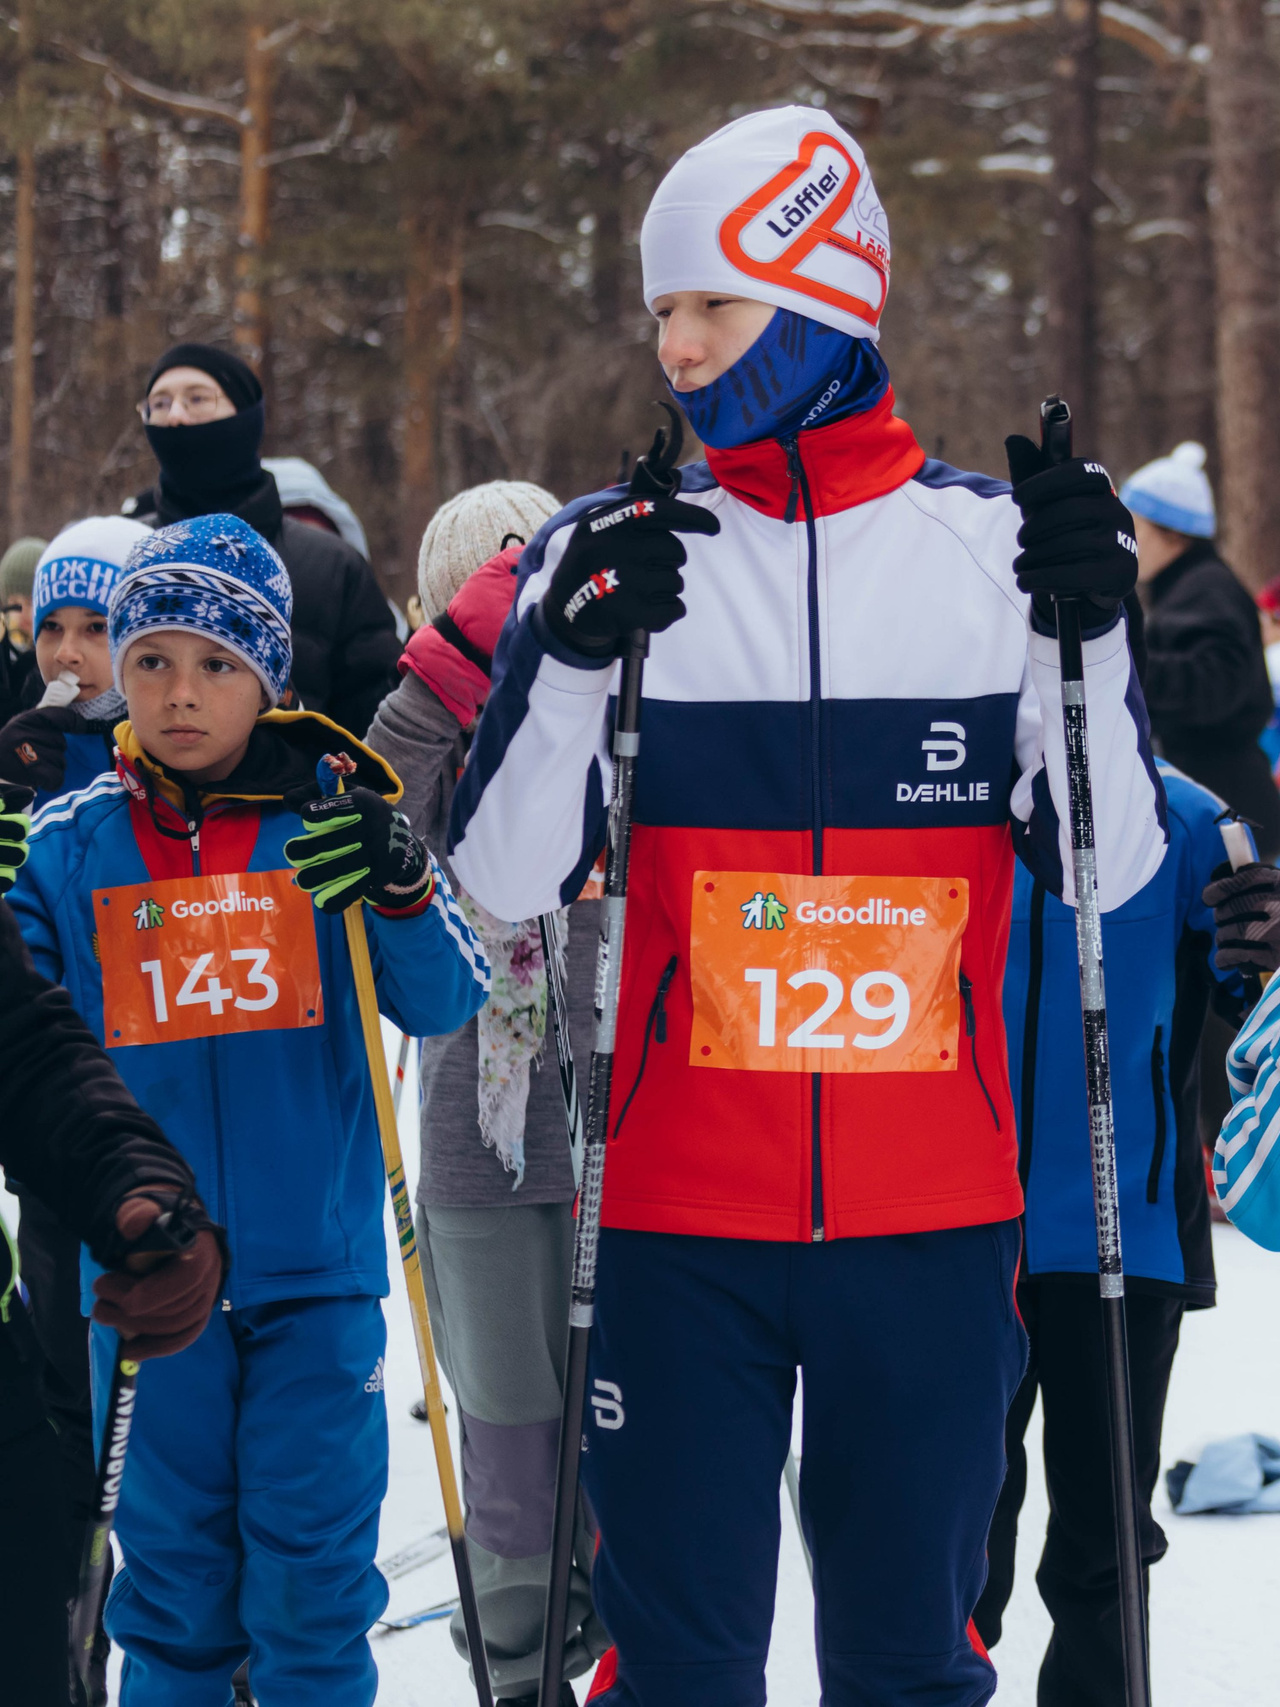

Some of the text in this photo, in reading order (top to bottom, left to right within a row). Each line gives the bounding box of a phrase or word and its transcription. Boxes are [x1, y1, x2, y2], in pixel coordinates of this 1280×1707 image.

[766, 165, 840, 239] Löffler
[896, 782, 989, 802] DÆHLIE
[171, 891, 274, 918] Goodline
[796, 898, 926, 926] Goodline
[140, 948, 279, 1023] 143
[744, 968, 911, 1050] 129
